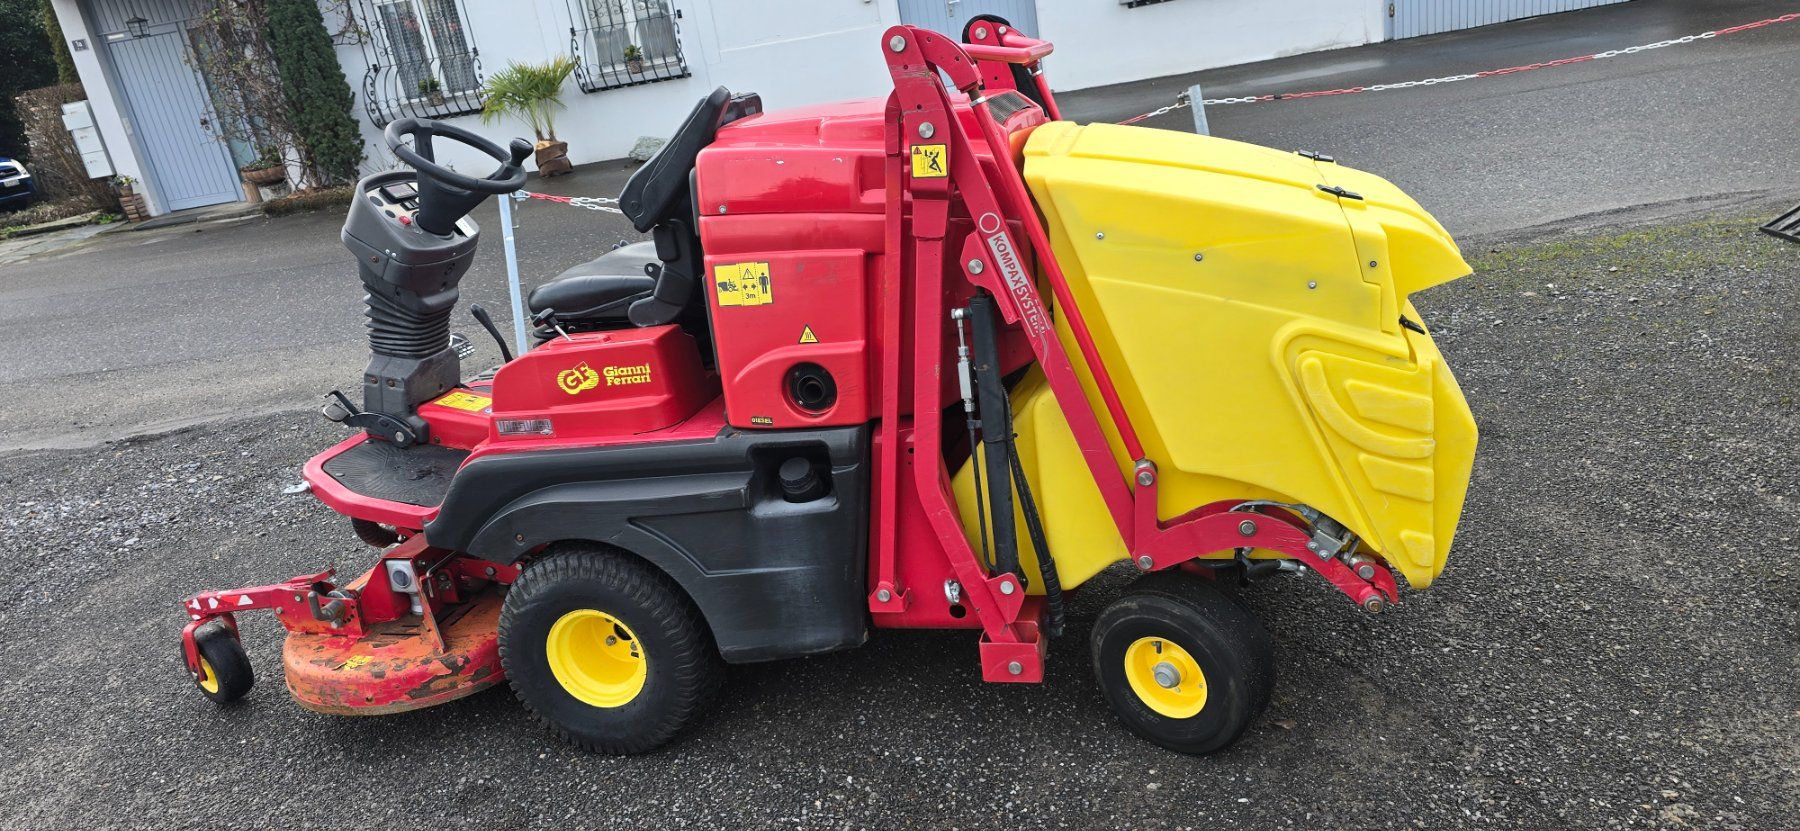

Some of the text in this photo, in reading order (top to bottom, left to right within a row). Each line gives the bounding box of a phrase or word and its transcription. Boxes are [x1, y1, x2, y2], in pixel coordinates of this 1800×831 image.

[992, 235, 1024, 288] KOMPAX
[745, 292, 756, 300] 3m
[603, 363, 651, 377] Gianni
[606, 374, 651, 386] Ferrari
